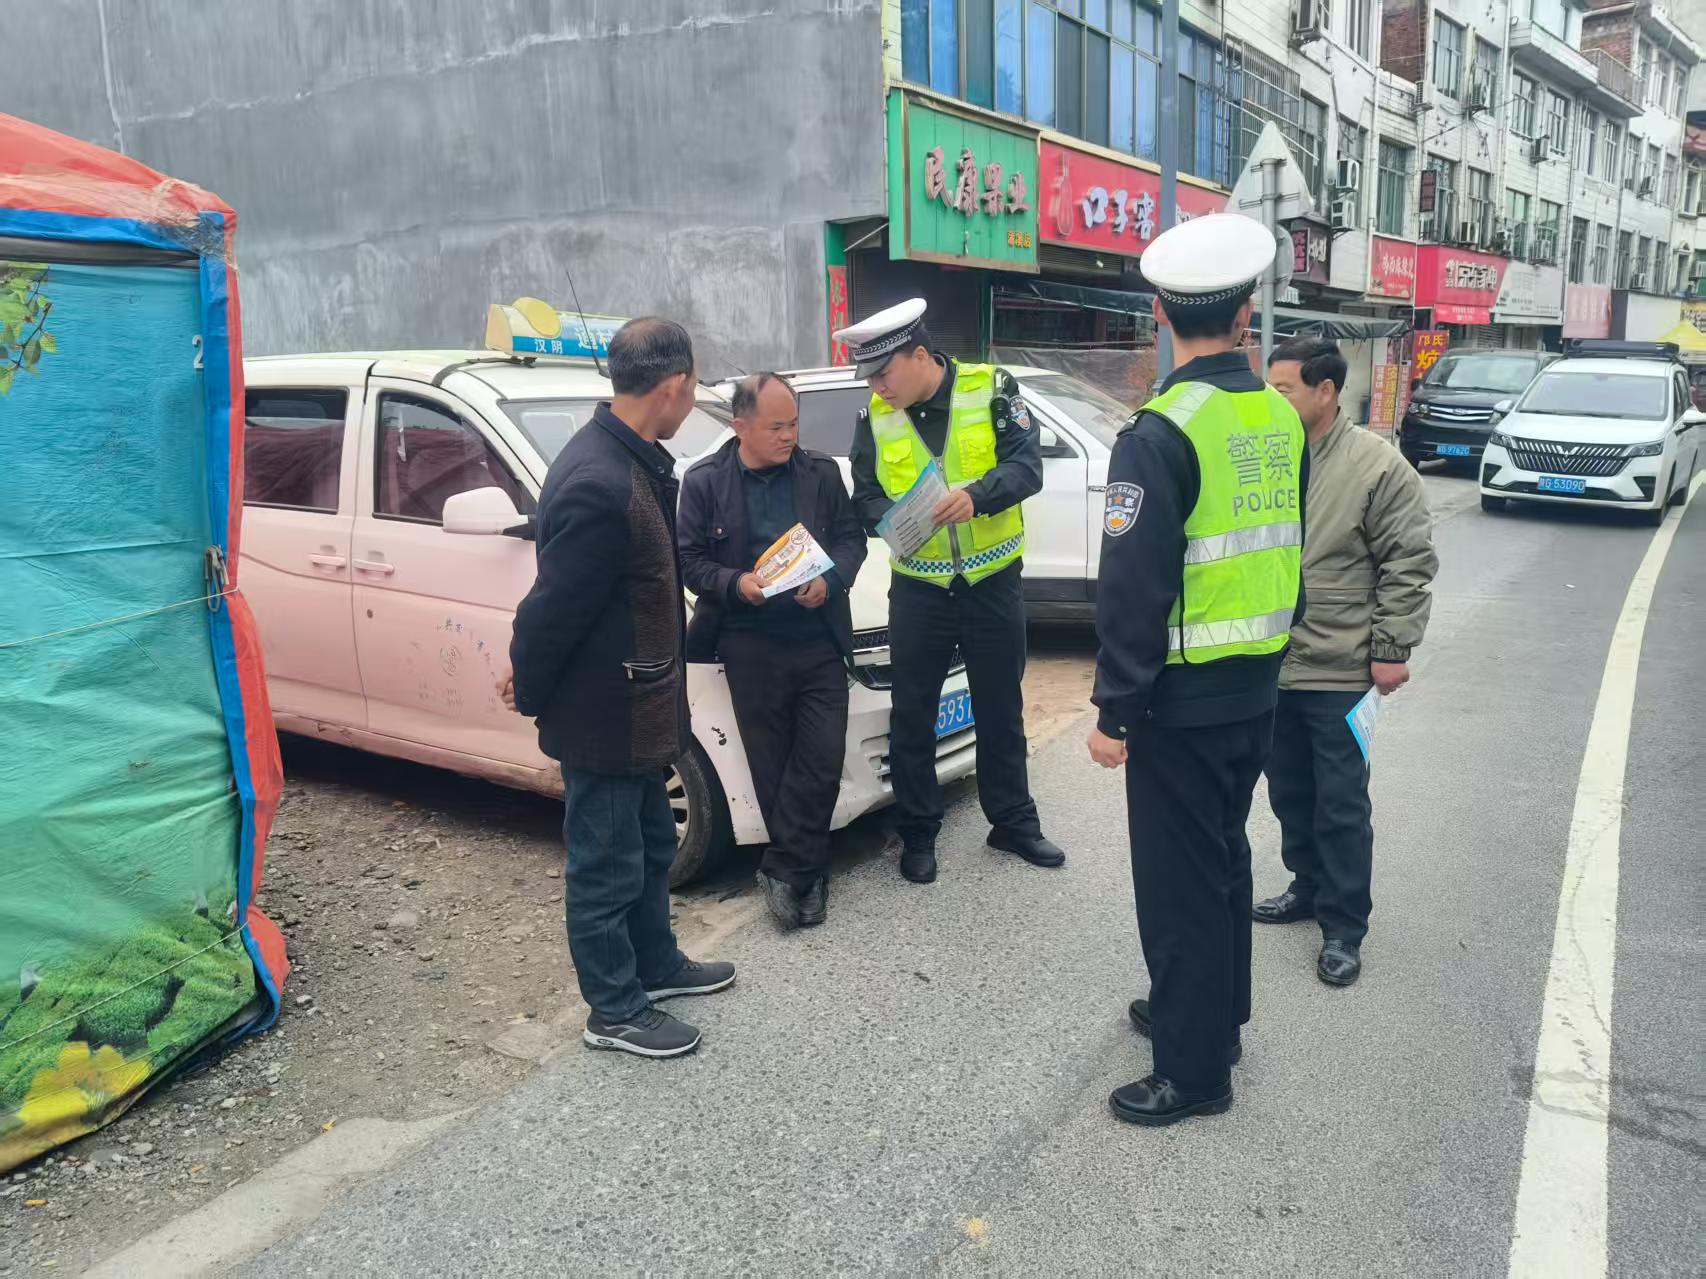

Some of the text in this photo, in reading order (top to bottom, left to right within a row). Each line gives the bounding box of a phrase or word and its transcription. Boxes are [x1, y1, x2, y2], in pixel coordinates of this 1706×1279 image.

[925, 146, 1029, 217] 民康果业
[1082, 186, 1155, 240] 口子窖
[192, 334, 204, 369] 2
[534, 338, 563, 354] 汉阴
[1226, 430, 1293, 487] 警察
[1231, 488, 1297, 517] POLICE
[938, 694, 972, 730] 5937
